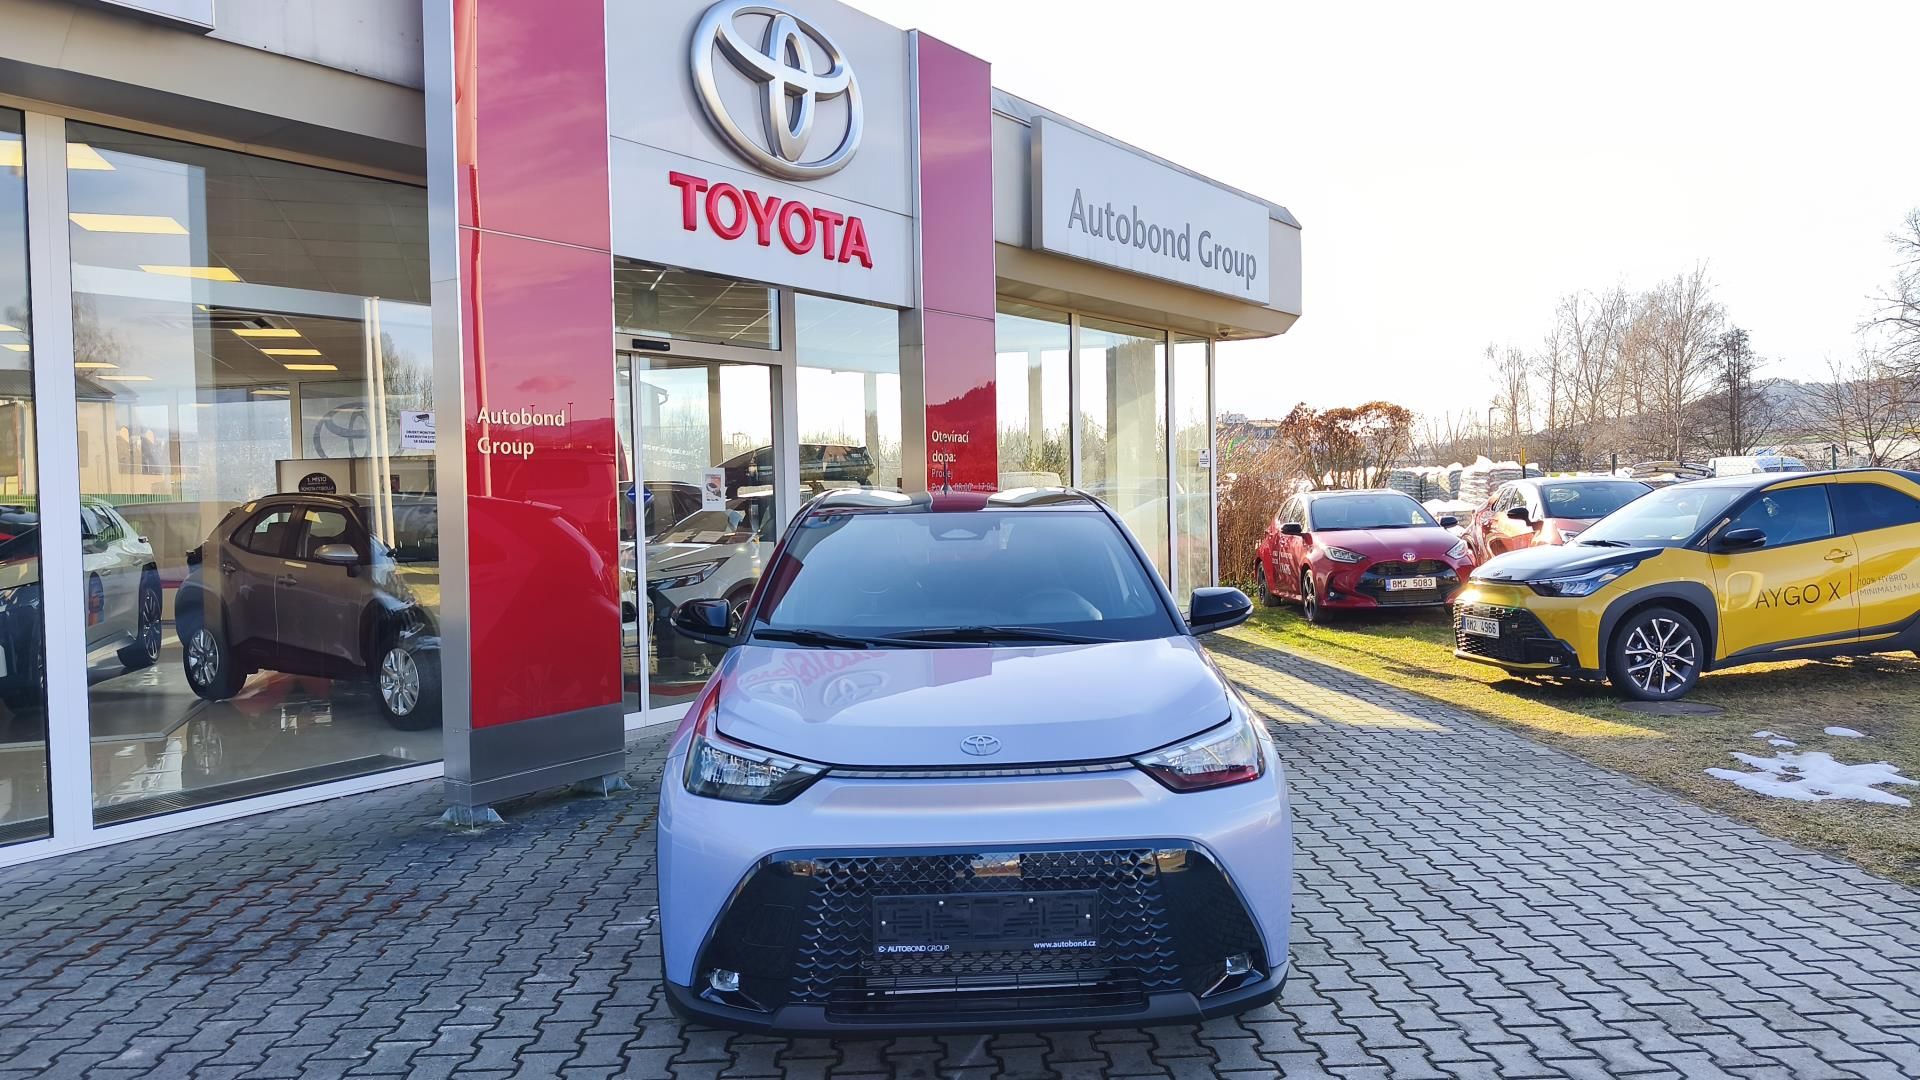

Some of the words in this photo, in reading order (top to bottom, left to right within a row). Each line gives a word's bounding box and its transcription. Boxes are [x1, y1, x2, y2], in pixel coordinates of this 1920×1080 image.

[669, 171, 873, 269] TOYOTA
[1068, 188, 1190, 262] Autobond
[1198, 230, 1257, 291] Group
[477, 406, 565, 427] Autobond
[931, 430, 970, 443] Otevírací
[477, 436, 535, 460] Group
[1412, 578, 1433, 587] 5083
[1755, 583, 1821, 609] AYGO
[1828, 581, 1841, 601] X
[887, 945, 926, 953] AUTOBOND
[927, 944, 950, 952] GROUP
[1033, 940, 1097, 949] www.autobond.cz
